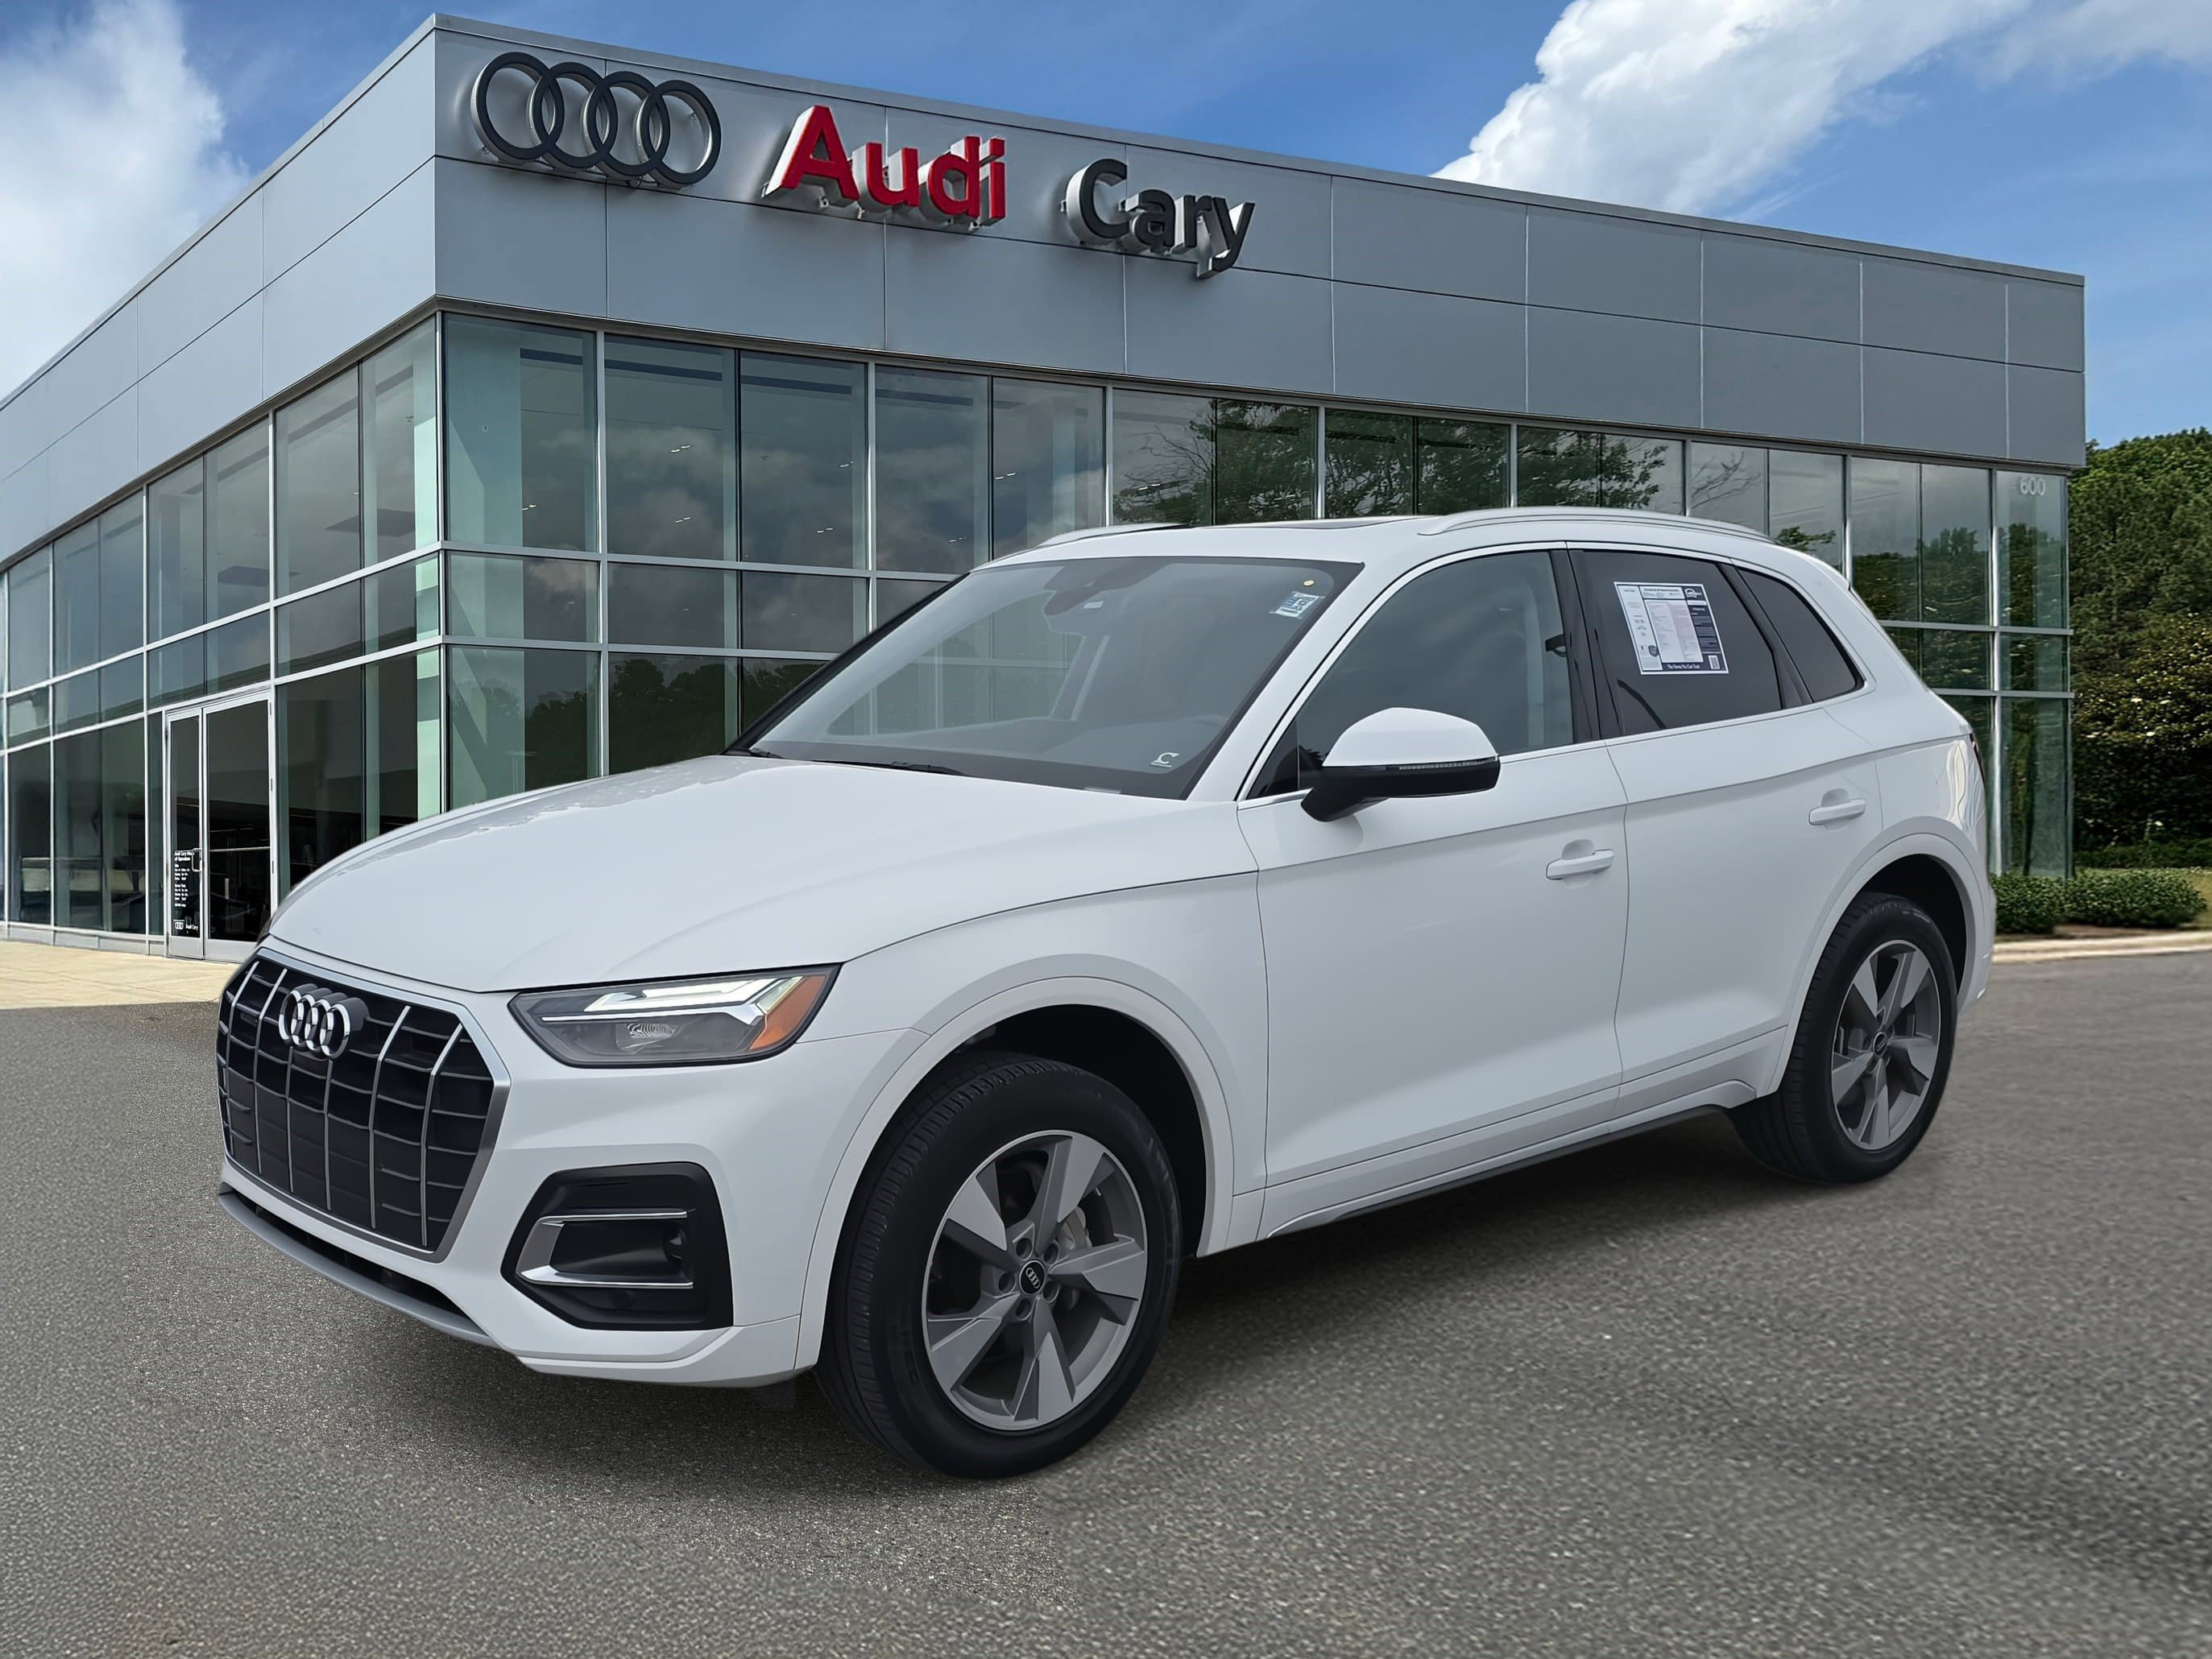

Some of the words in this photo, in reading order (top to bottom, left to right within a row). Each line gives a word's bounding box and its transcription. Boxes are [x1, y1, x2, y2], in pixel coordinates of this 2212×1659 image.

[764, 105, 1005, 228] Audi
[1065, 158, 1255, 277] Cary
[2020, 476, 2046, 495] 600
